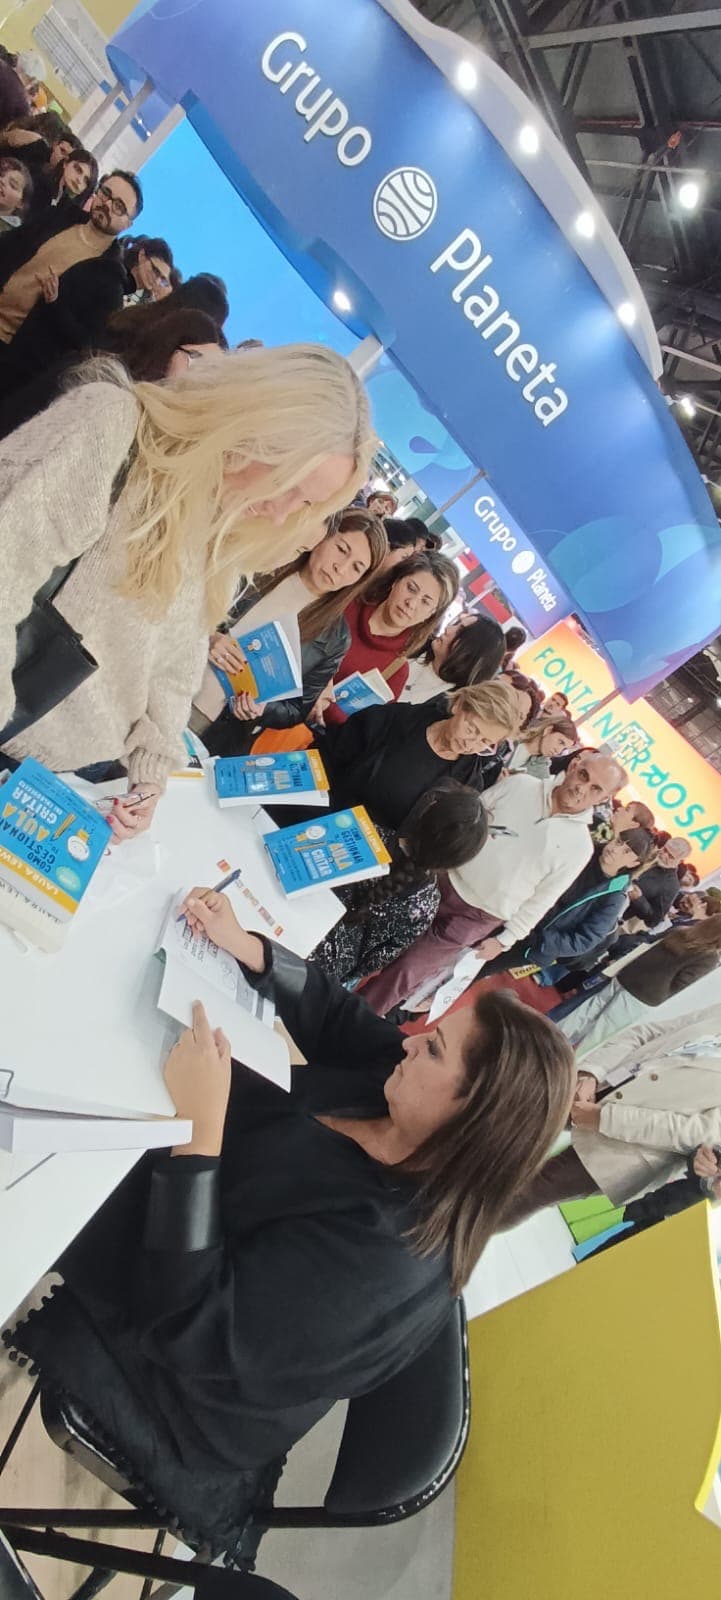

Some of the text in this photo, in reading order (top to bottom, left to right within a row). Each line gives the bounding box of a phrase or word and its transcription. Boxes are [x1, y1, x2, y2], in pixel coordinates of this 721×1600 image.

[261, 31, 569, 427] Grupo Planeta
[474, 495, 557, 612] Grupo Planeta
[533, 646, 720, 851] FONTANRROSA
[2, 801, 50, 842] AULA
[12, 786, 58, 825] GRITAR
[27, 852, 52, 873] COMO
[329, 842, 353, 870] AULA
[24, 867, 60, 896] LAURA
